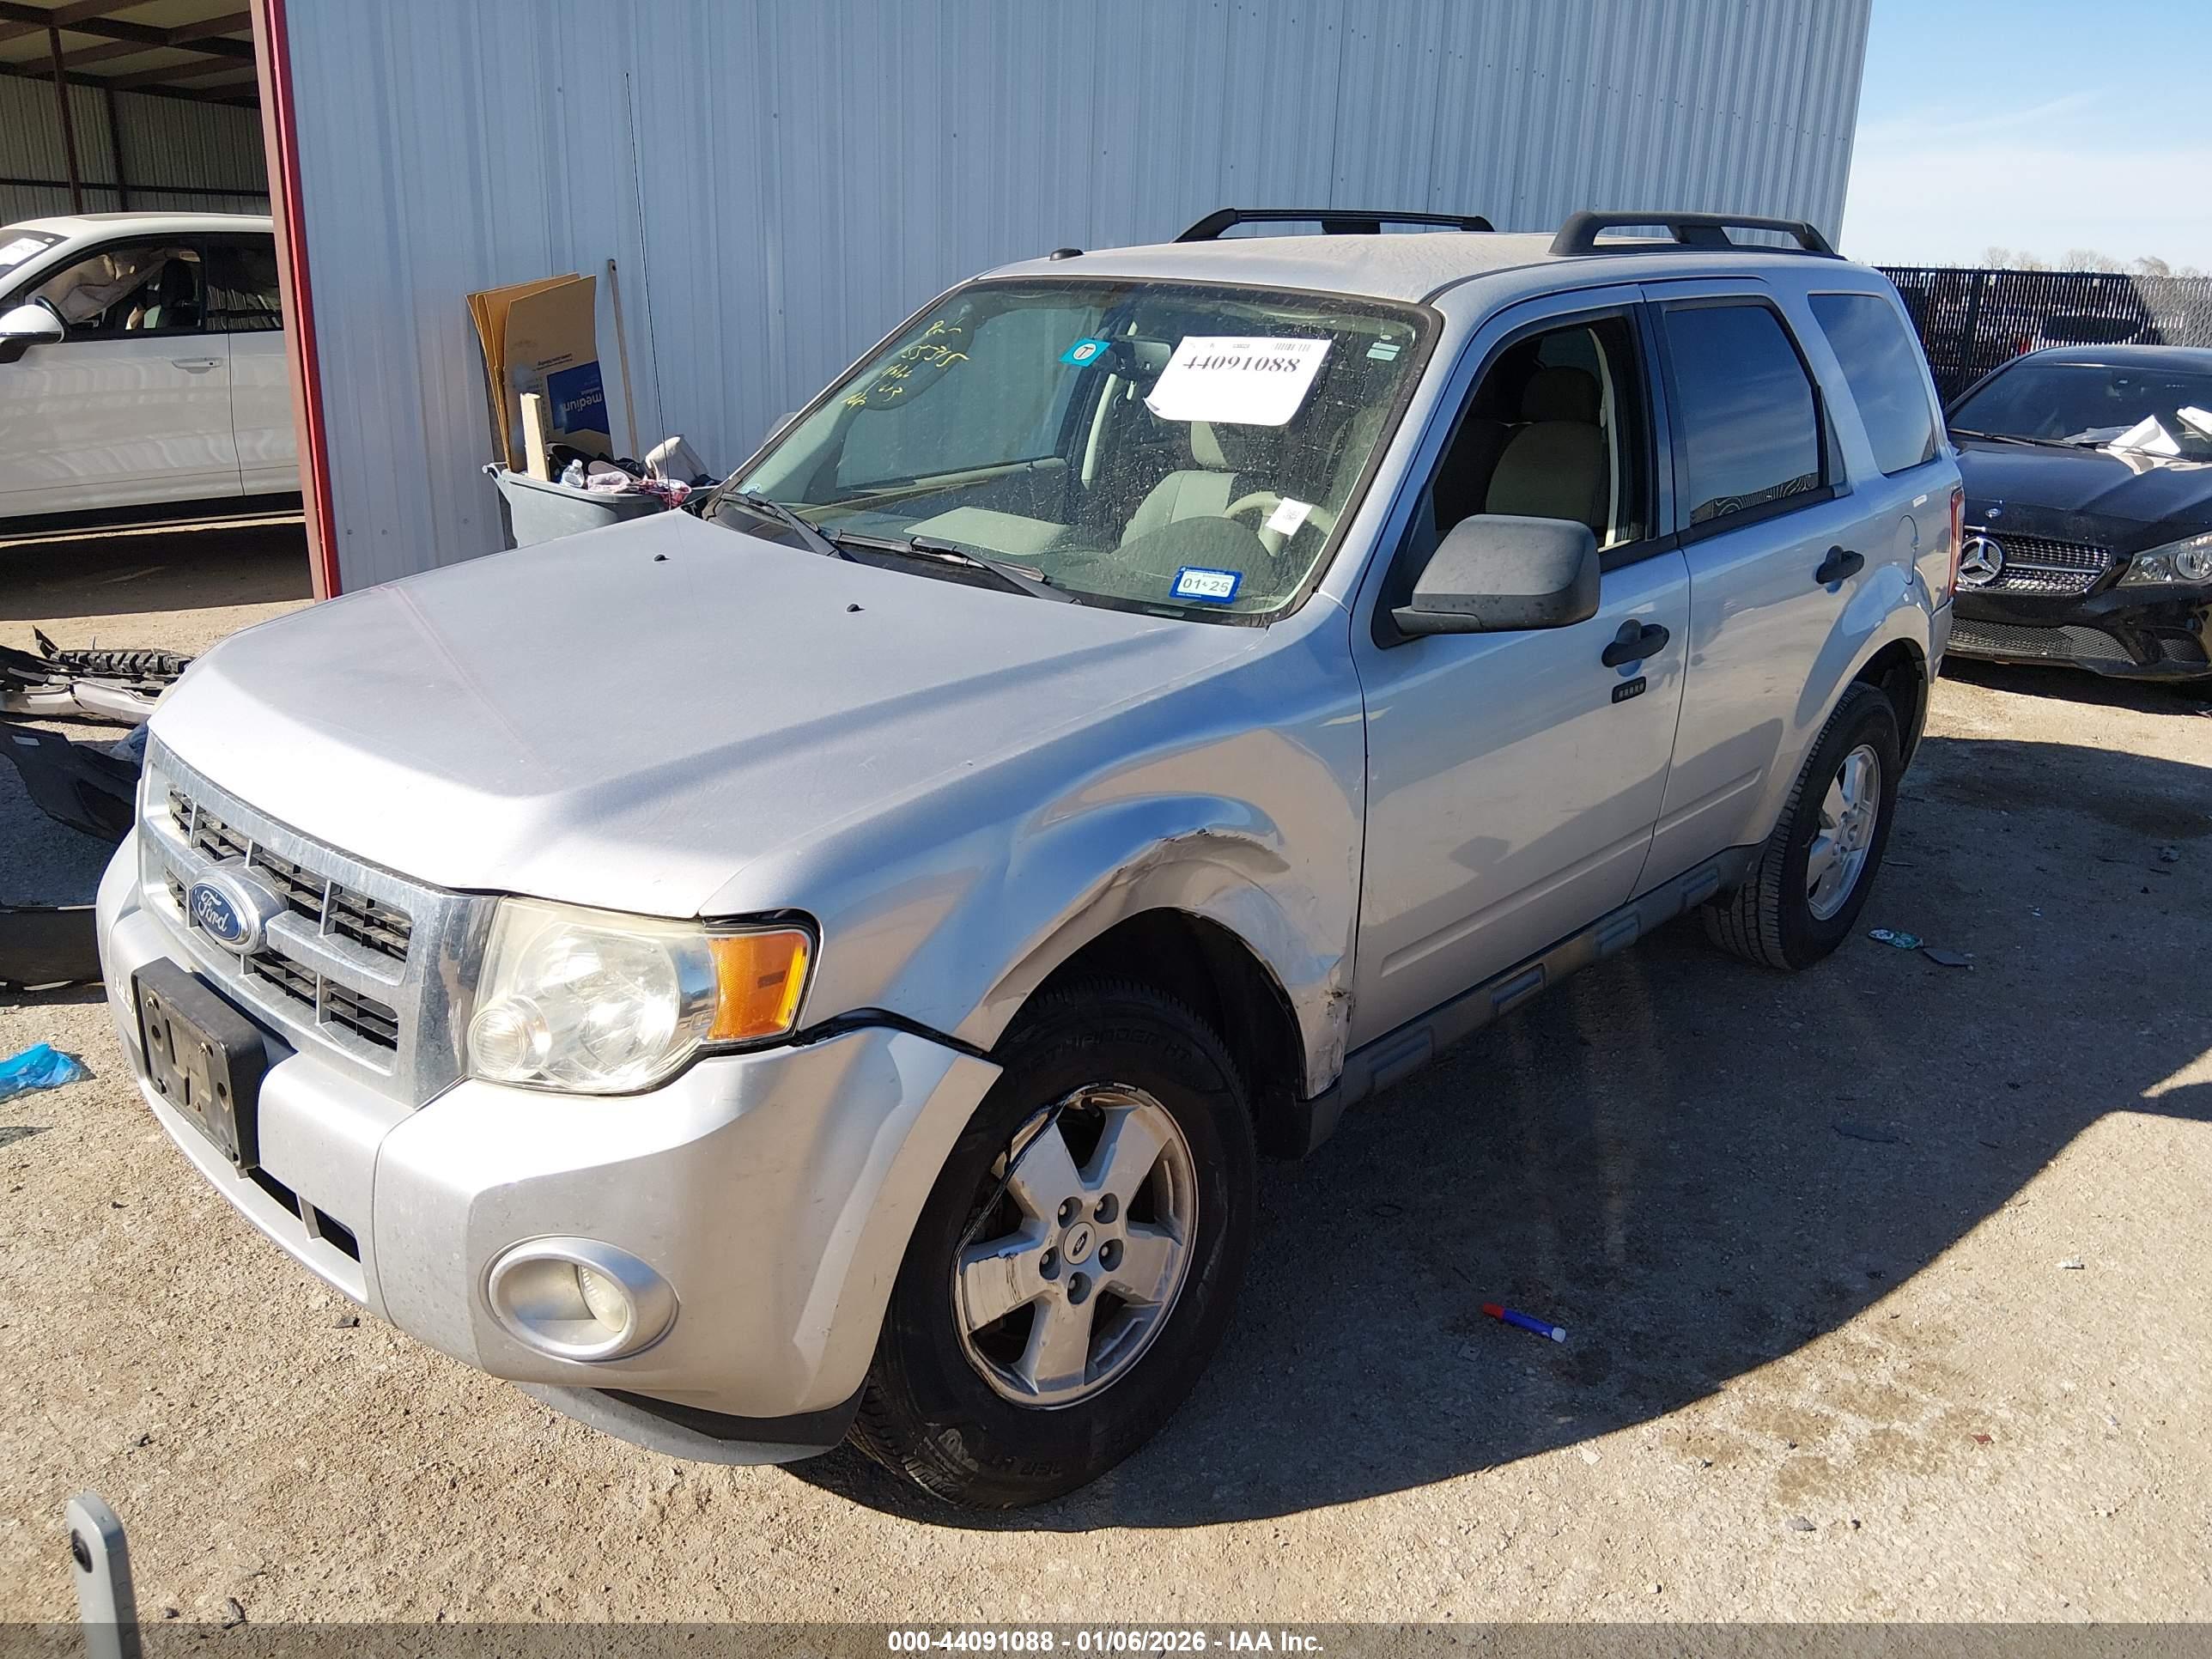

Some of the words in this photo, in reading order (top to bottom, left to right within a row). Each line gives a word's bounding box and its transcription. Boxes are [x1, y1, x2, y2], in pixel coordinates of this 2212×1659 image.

[1182, 355, 1301, 373] 44091088
[1182, 578, 1201, 590] 01
[1208, 580, 1231, 592] 25
[198, 890, 229, 932] Ford
